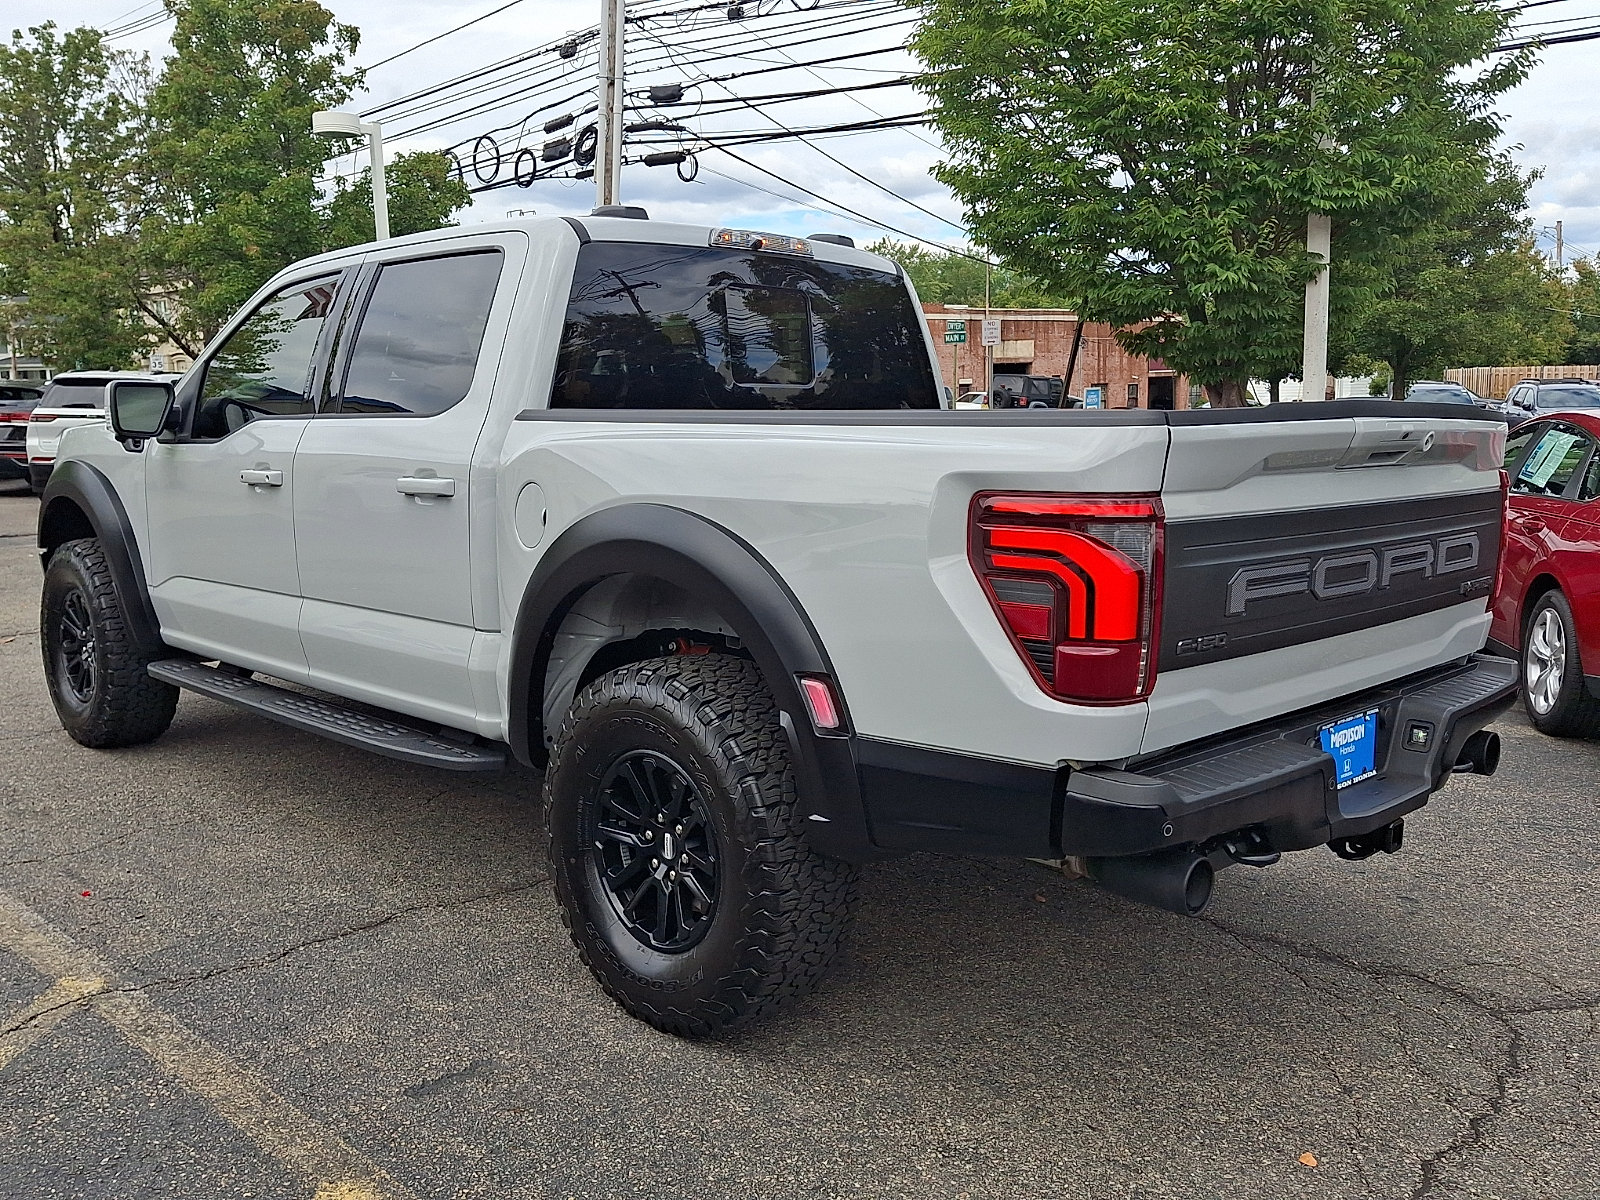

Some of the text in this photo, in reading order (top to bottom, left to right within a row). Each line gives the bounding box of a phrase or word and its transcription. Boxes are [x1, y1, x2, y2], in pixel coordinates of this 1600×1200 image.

[945, 334, 959, 342] MAIN
[152, 361, 163, 369] 35
[1224, 531, 1480, 617] FORD
[1330, 724, 1365, 749] MADISON
[1340, 743, 1356, 756] Honda
[1353, 769, 1378, 784] HONDA
